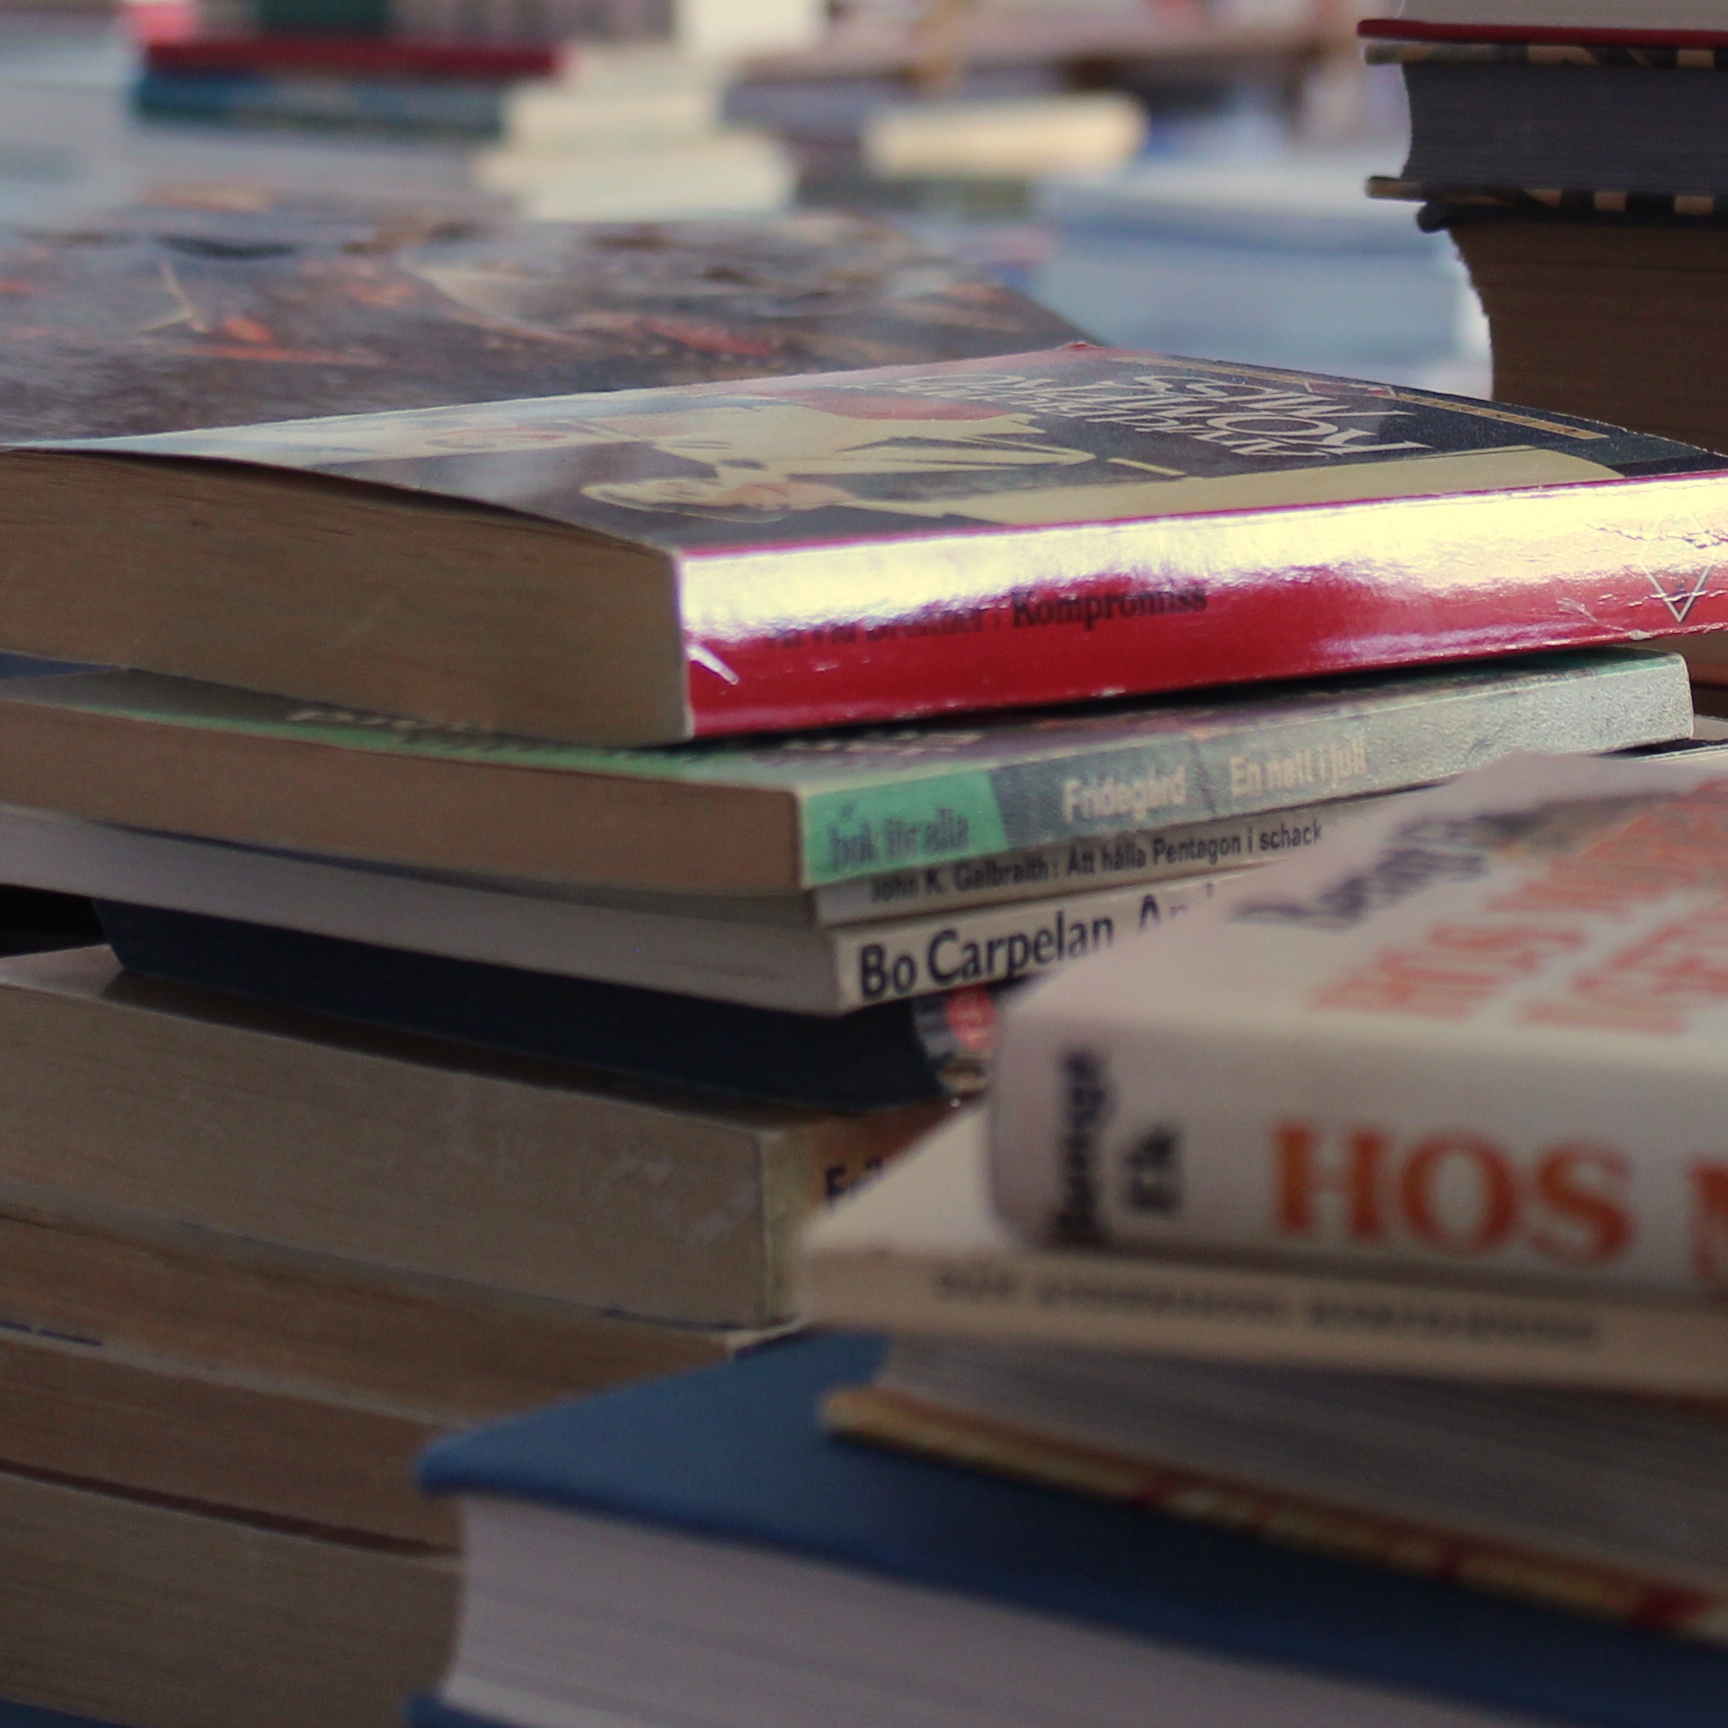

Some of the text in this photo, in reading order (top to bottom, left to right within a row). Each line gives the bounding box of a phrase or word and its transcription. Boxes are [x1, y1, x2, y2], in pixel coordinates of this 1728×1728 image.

[1010, 583, 1209, 631] Kompromiss
[1152, 831, 1243, 872] Pentagon
[1259, 818, 1322, 854] schack
[858, 909, 1116, 1002] Bo Carpelan
[1270, 1120, 1640, 1269] HOS
